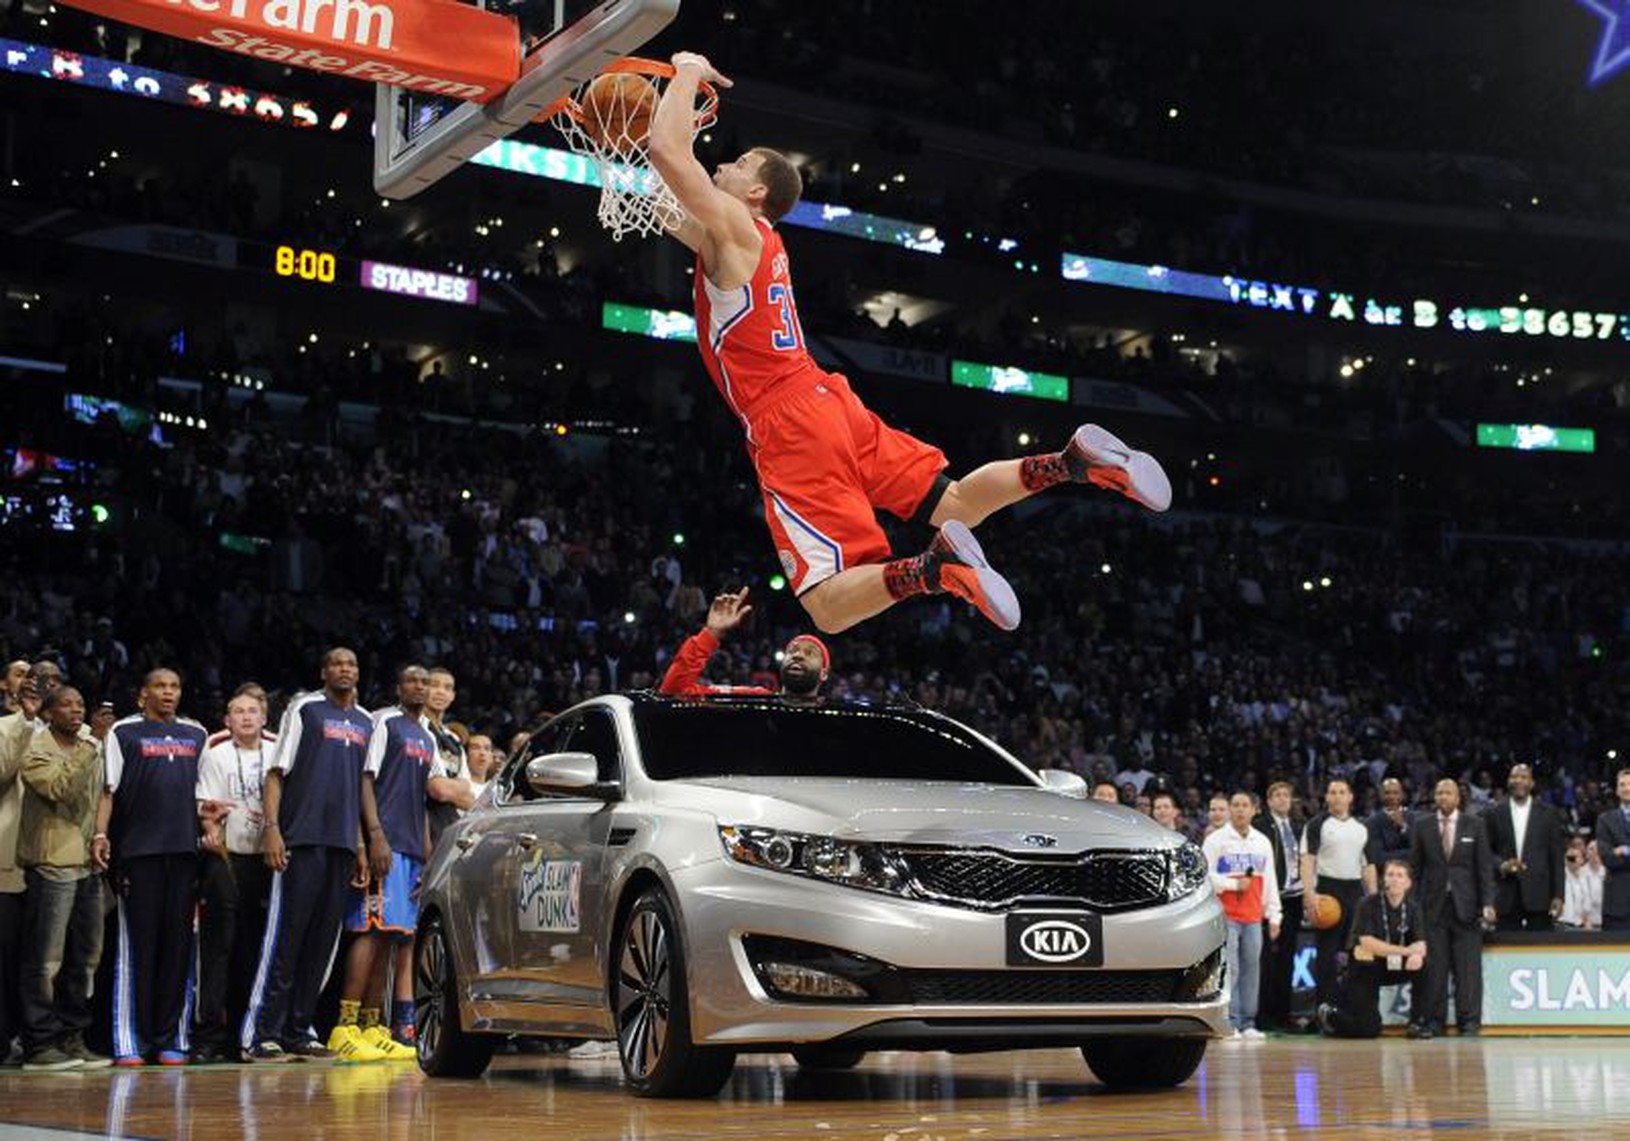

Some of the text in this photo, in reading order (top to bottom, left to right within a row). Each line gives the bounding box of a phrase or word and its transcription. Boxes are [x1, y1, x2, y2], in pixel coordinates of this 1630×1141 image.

[197, 27, 488, 99] State Farm
[275, 246, 336, 283] 8:00
[370, 264, 470, 302] STAPLES
[1228, 278, 1318, 314] TEXT
[1328, 293, 1354, 321] A
[1413, 300, 1439, 328] B
[1499, 306, 1617, 340] 38657
[1033, 930, 1079, 953] KIA
[1509, 968, 1630, 1011] SLAM
